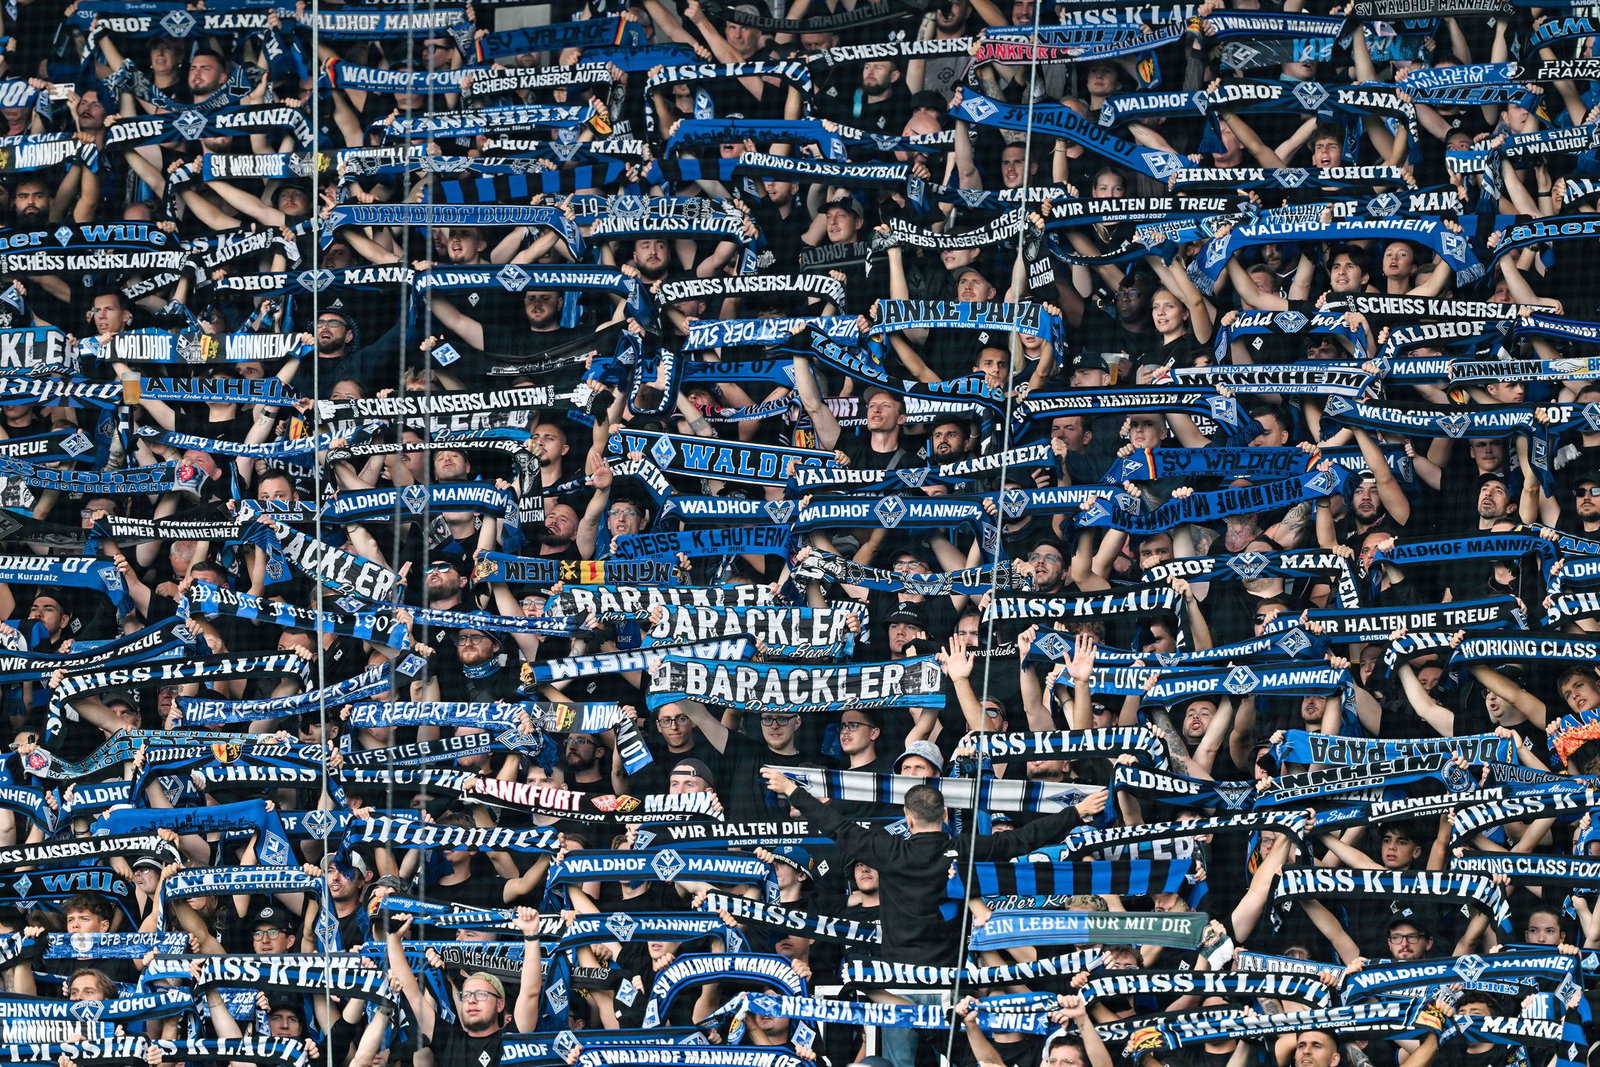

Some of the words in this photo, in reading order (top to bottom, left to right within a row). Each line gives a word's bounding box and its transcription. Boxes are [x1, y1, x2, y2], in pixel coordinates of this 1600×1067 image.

[1356, 3, 1373, 15] SV
[1378, 1, 1435, 14] WALDHOF
[1438, 0, 1500, 12] MANNHEIM
[1230, 17, 1284, 31] WALDHOF
[1287, 20, 1340, 35] MANNHE
[830, 42, 898, 61] SCHEISS
[473, 78, 518, 95] SCHEISS
[1113, 94, 1189, 112] WALDHOF
[1513, 132, 1544, 145] EINE
[1547, 126, 1589, 140] STADT
[1505, 148, 1522, 157] SV
[1525, 137, 1589, 155] WALDHOF
[210, 155, 229, 177] SV
[230, 153, 285, 176] WALDHOF
[796, 161, 839, 175] CLASS
[843, 164, 907, 180] FOOTBALL
[352, 206, 474, 223] WALDHOF
[659, 197, 677, 218] 07
[1052, 200, 1085, 219] WIR
[1089, 198, 1145, 214] HALTEN
[1149, 198, 1175, 211] DIE
[1180, 197, 1227, 211] TREUE
[80, 224, 167, 246] Wille
[1239, 221, 1331, 242] WALDHOF
[8, 254, 64, 271] SCHEISS
[67, 250, 181, 271] KAISERSLAUTERN
[1029, 257, 1051, 277] ANTI
[534, 271, 623, 287] MANNHEIM
[662, 279, 722, 301] SCHEISS
[969, 302, 1042, 327] PAPA
[1356, 297, 1425, 315] SCHEISS
[115, 335, 173, 360] WALDHOF
[359, 396, 417, 416] SCHEISS
[418, 386, 546, 413] KAISERSLAUTERN
[1026, 397, 1093, 413] WALDHOF
[1100, 393, 1178, 407] MANNHEIM
[1181, 393, 1201, 405] 07
[351, 442, 403, 456] SCHEISS
[938, 443, 1052, 477] MANNHEIM
[433, 488, 507, 507] MANNHEIM
[519, 496, 543, 509] ANTI
[680, 501, 760, 514] WALDHOF
[799, 505, 869, 522] WALDHOF
[909, 504, 982, 520] MANNHEIM
[112, 524, 155, 538] IMMER
[159, 526, 239, 539] MANNHEIMER
[62, 556, 96, 573] 07
[18, 573, 58, 582] Kurpfalz
[1345, 614, 1408, 632] HALTEN
[1411, 613, 1437, 629] DIE
[1444, 607, 1499, 625] TREUE
[1461, 640, 1537, 660] WORKING
[1541, 640, 1596, 658] CLASS
[686, 661, 905, 706] BARACKLER
[186, 700, 226, 720] HIER
[382, 702, 452, 720] REGIERT
[458, 701, 491, 718] DER
[442, 732, 491, 752] 1999
[668, 824, 707, 840] WIR
[712, 823, 780, 837] HALTEN
[784, 821, 808, 835] DIE
[728, 838, 758, 846] SAISON
[760, 837, 803, 846] 2026/2027
[564, 859, 647, 874] WALDHOF
[1516, 858, 1567, 876] CLASS
[41, 872, 129, 895] Wille
[984, 918, 1014, 936] EIN
[1019, 917, 1078, 931] LEBEN
[1084, 916, 1121, 929] NUR
[1124, 917, 1158, 931] MIT
[1162, 919, 1192, 935] DIR
[100, 933, 161, 946] DFB-POKAL
[1354, 965, 1448, 988] WALDHOF
[1277, 1024, 1295, 1033] DER
[1315, 1019, 1357, 1028] VERGEHT
[601, 1048, 681, 1066] WALDHOF
